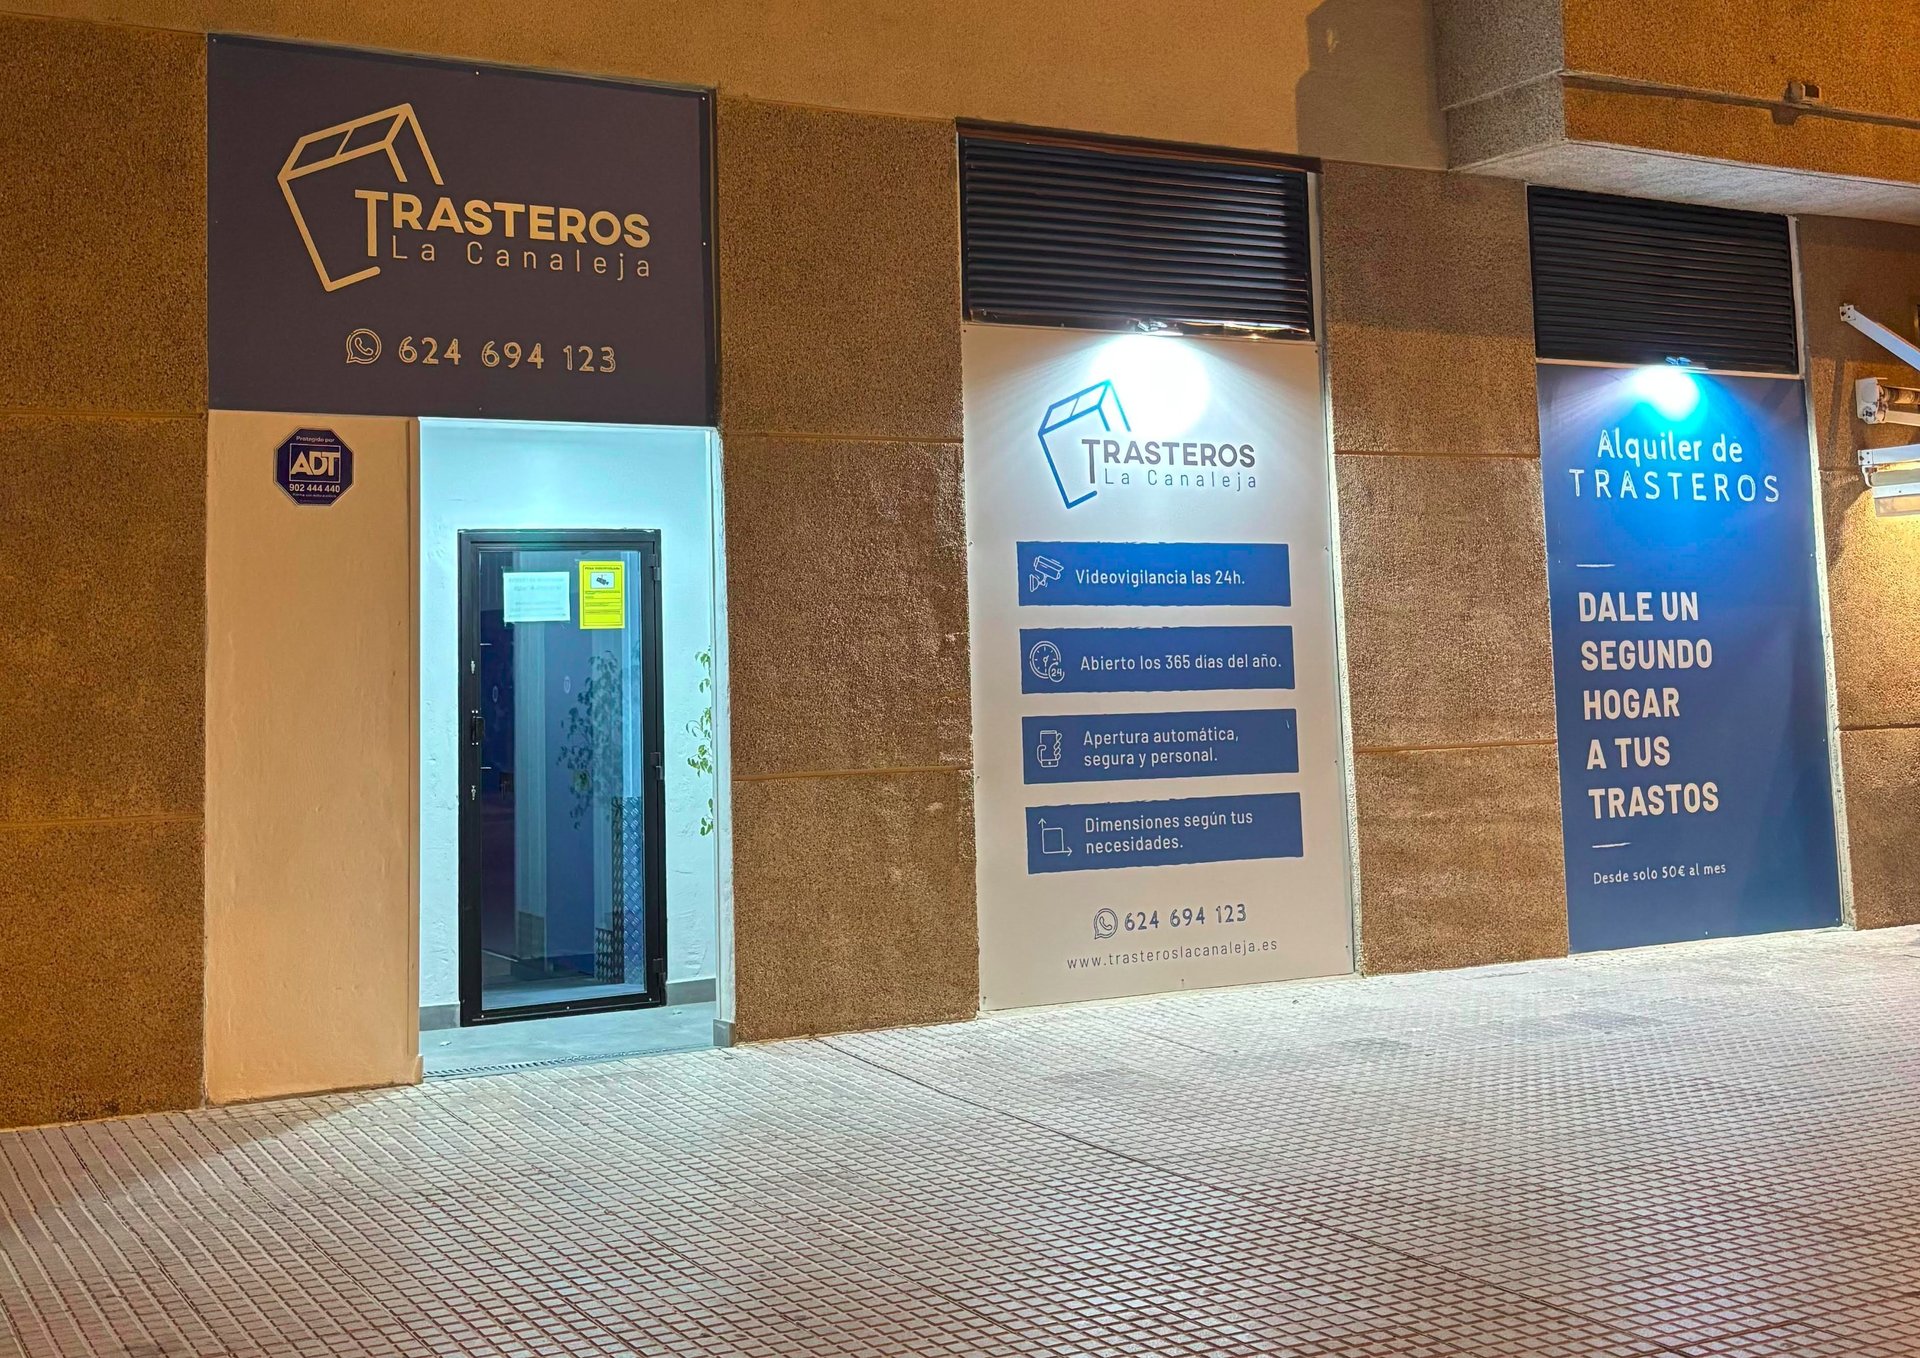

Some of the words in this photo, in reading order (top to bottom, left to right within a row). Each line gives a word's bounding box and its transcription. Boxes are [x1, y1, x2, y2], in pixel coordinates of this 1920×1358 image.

[354, 189, 651, 257] TRASTEROS
[391, 235, 436, 262] La
[466, 240, 650, 281] Canaleja
[398, 336, 461, 366] 624
[481, 340, 545, 369] 694
[562, 345, 617, 373] 123
[1081, 438, 1256, 484] TRASTEROS
[1597, 427, 1703, 467] Alquiler
[1712, 433, 1743, 463] de
[291, 450, 340, 476] ADT
[289, 483, 305, 492] 902
[306, 484, 323, 492] 444
[324, 484, 341, 493] 440
[1104, 468, 1130, 486] La
[1147, 469, 1257, 492] Canaleja
[1569, 468, 1780, 503] TRASTEROS
[1075, 568, 1188, 588] Videovigilancia
[1191, 570, 1212, 585] las
[1214, 570, 1246, 585] 24h.
[1578, 591, 1653, 622] DALE
[1661, 591, 1699, 621] UN
[1080, 656, 1136, 671] Abierto
[1139, 655, 1161, 670] los
[1164, 655, 1191, 670] 365
[1194, 654, 1225, 669] días
[1227, 653, 1249, 668] del
[1252, 654, 1282, 668] año.
[1581, 639, 1713, 671] SEGUNDO
[1051, 668, 1063, 677] 24
[1583, 687, 1680, 720] HOGAR
[1083, 729, 1149, 749] Apertura
[1153, 726, 1239, 745] automática,
[1083, 751, 1135, 769] segura
[1138, 752, 1147, 767] y
[1150, 747, 1218, 767] personal.
[1586, 739, 1607, 770] A
[1614, 736, 1671, 768] TUS
[1588, 781, 1719, 819] TRASTOS
[1084, 816, 1180, 834] Dimensiones
[1183, 811, 1227, 830] según
[1230, 812, 1253, 825] tus
[1085, 836, 1184, 854] necesidades.
[1593, 870, 1629, 885] Desde
[1632, 867, 1658, 881] solo
[1661, 865, 1686, 879] 50€
[1689, 863, 1700, 876] al
[1703, 863, 1726, 875] mes
[1124, 910, 1160, 931] 624
[1169, 906, 1206, 927] 694
[1215, 903, 1247, 924] 123
[1067, 938, 1278, 969] www.trasteroslacanaleja.es
